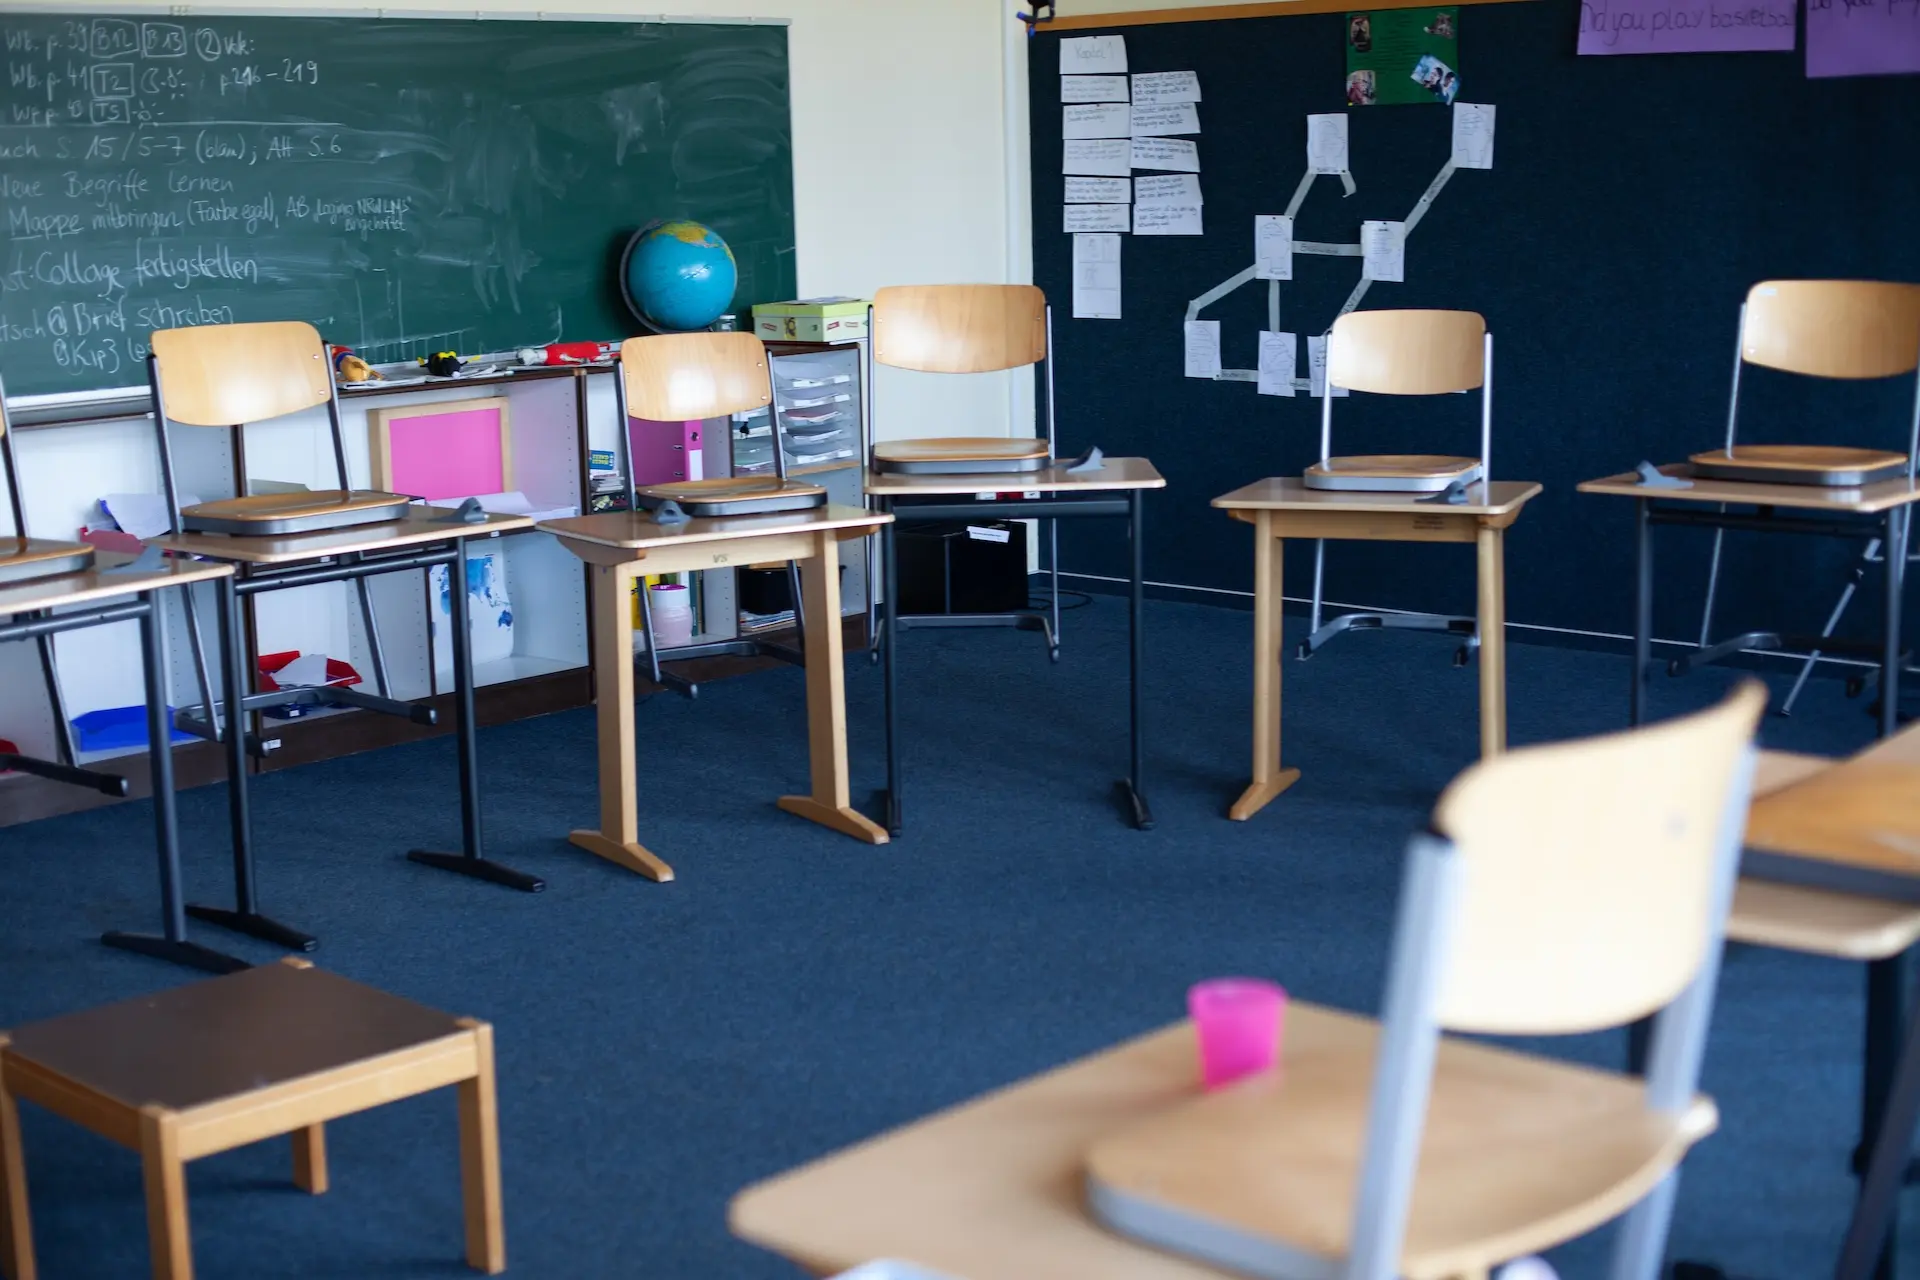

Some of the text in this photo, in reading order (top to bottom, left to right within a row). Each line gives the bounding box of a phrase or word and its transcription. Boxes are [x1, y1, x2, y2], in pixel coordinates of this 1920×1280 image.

[64, 21, 87, 52] 39
[1603, 11, 1647, 46] you
[1651, 7, 1704, 41] play
[67, 60, 88, 91] 41
[62, 169, 150, 207] Begriffe
[8, 206, 85, 240] Mappe
[286, 196, 310, 218] AB
[36, 250, 126, 299] Collage
[135, 237, 258, 289] fertigstellen
[73, 293, 127, 337] Brief
[135, 294, 234, 329] schreiben
